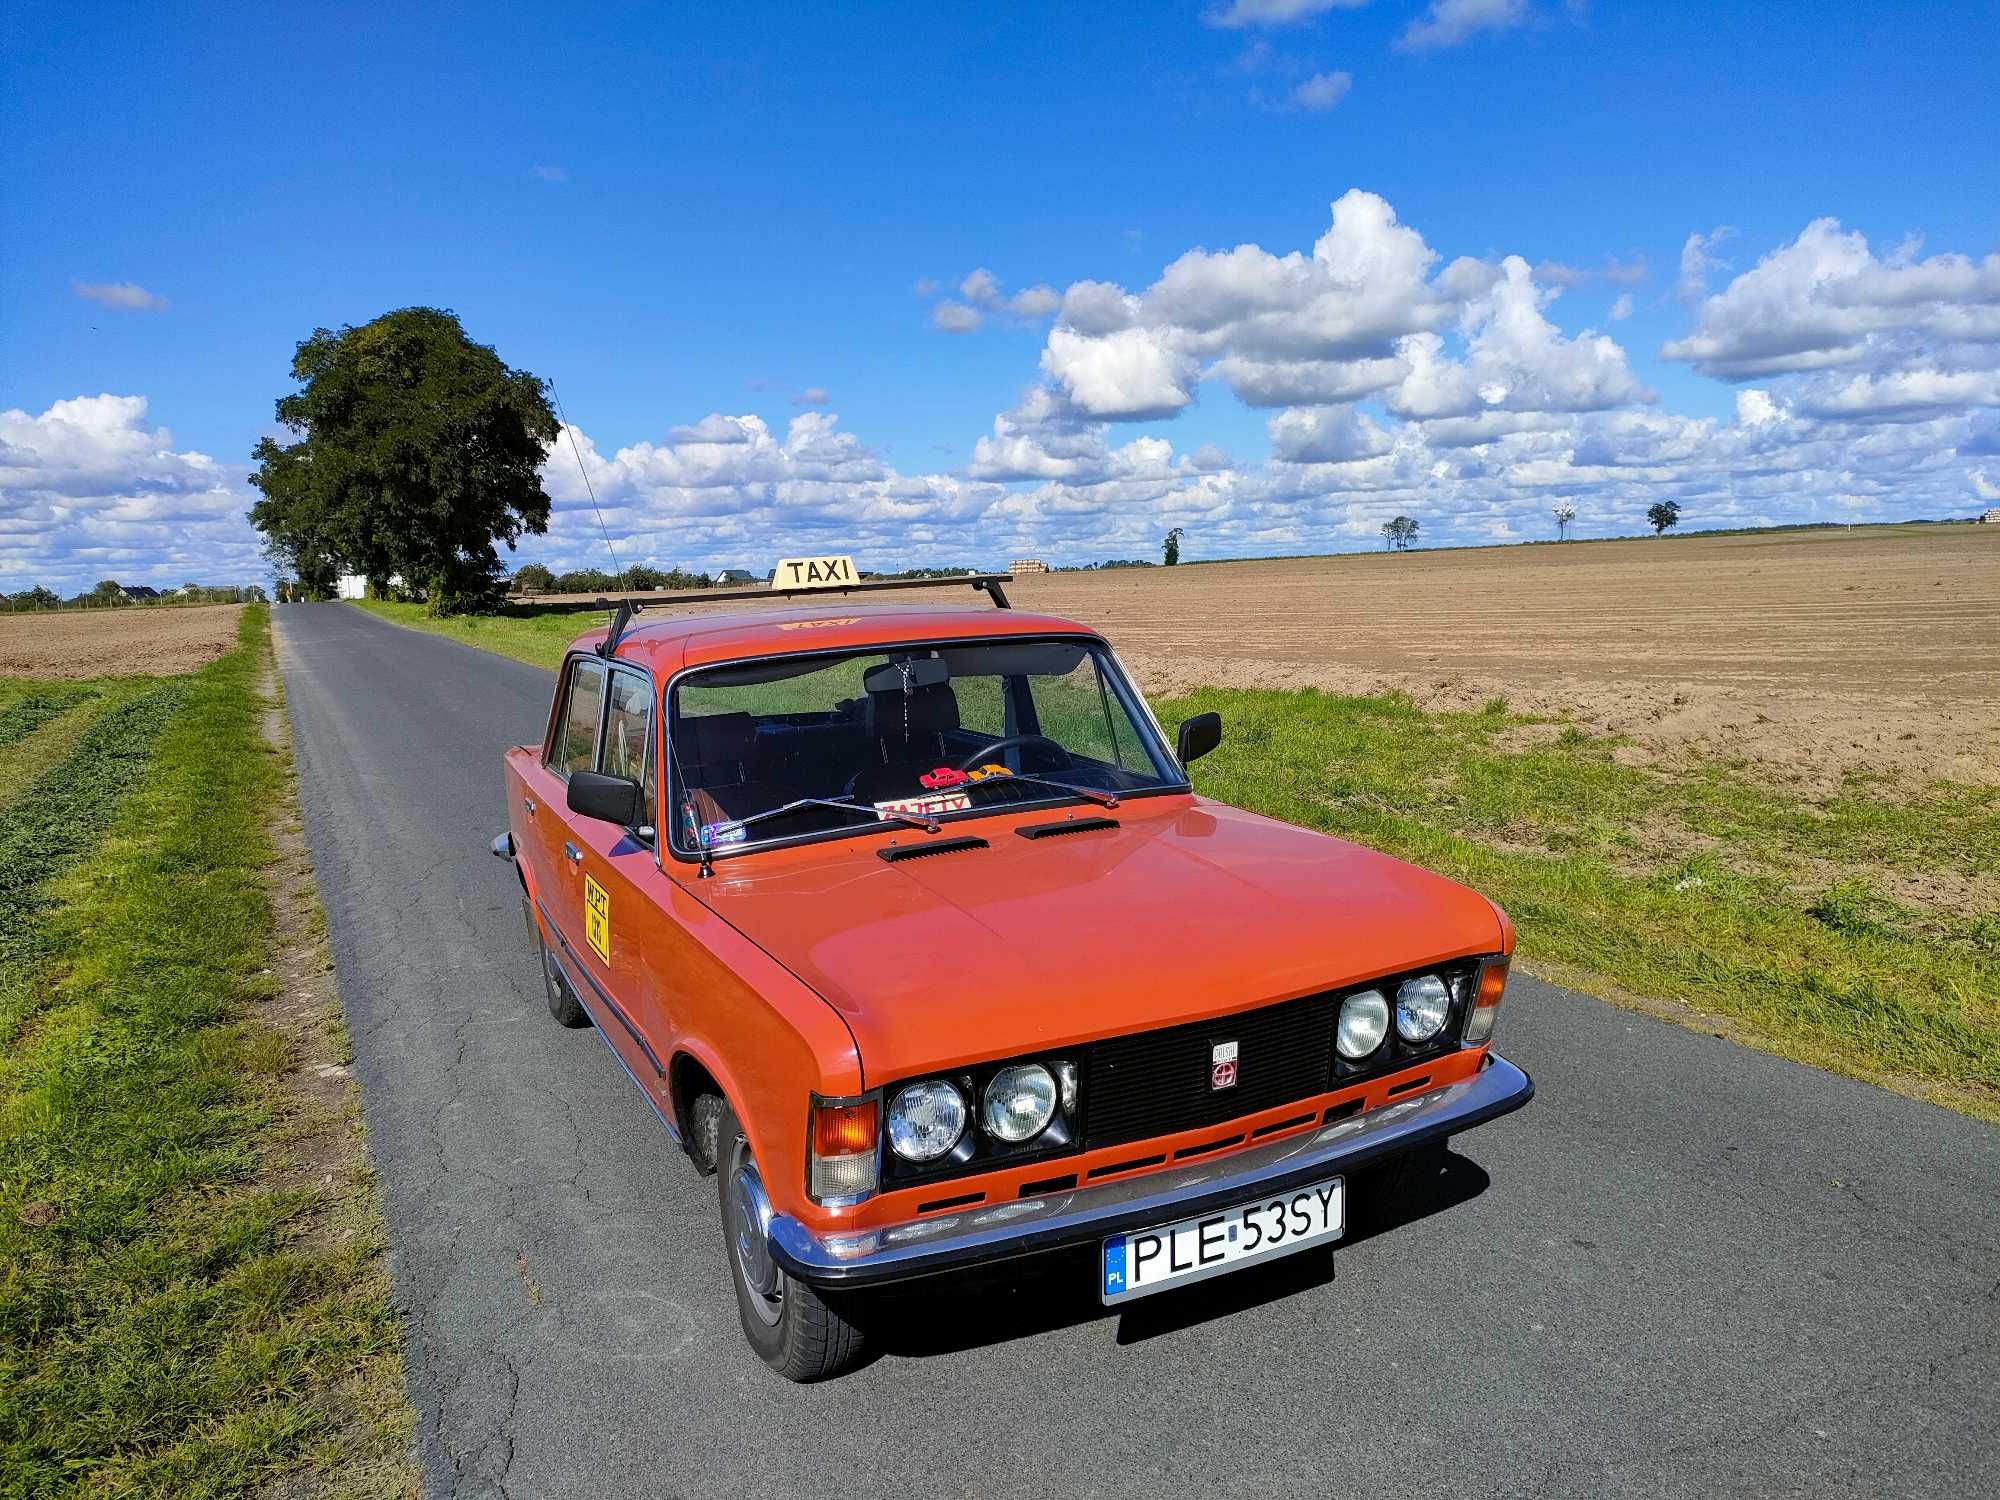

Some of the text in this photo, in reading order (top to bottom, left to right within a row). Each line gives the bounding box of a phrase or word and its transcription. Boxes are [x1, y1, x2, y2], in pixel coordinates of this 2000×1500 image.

[786, 559, 849, 584] TAXI
[587, 879, 607, 915] WPT
[1134, 1184, 1336, 1282] PLE 53SY
[1108, 1272, 1124, 1286] PL
